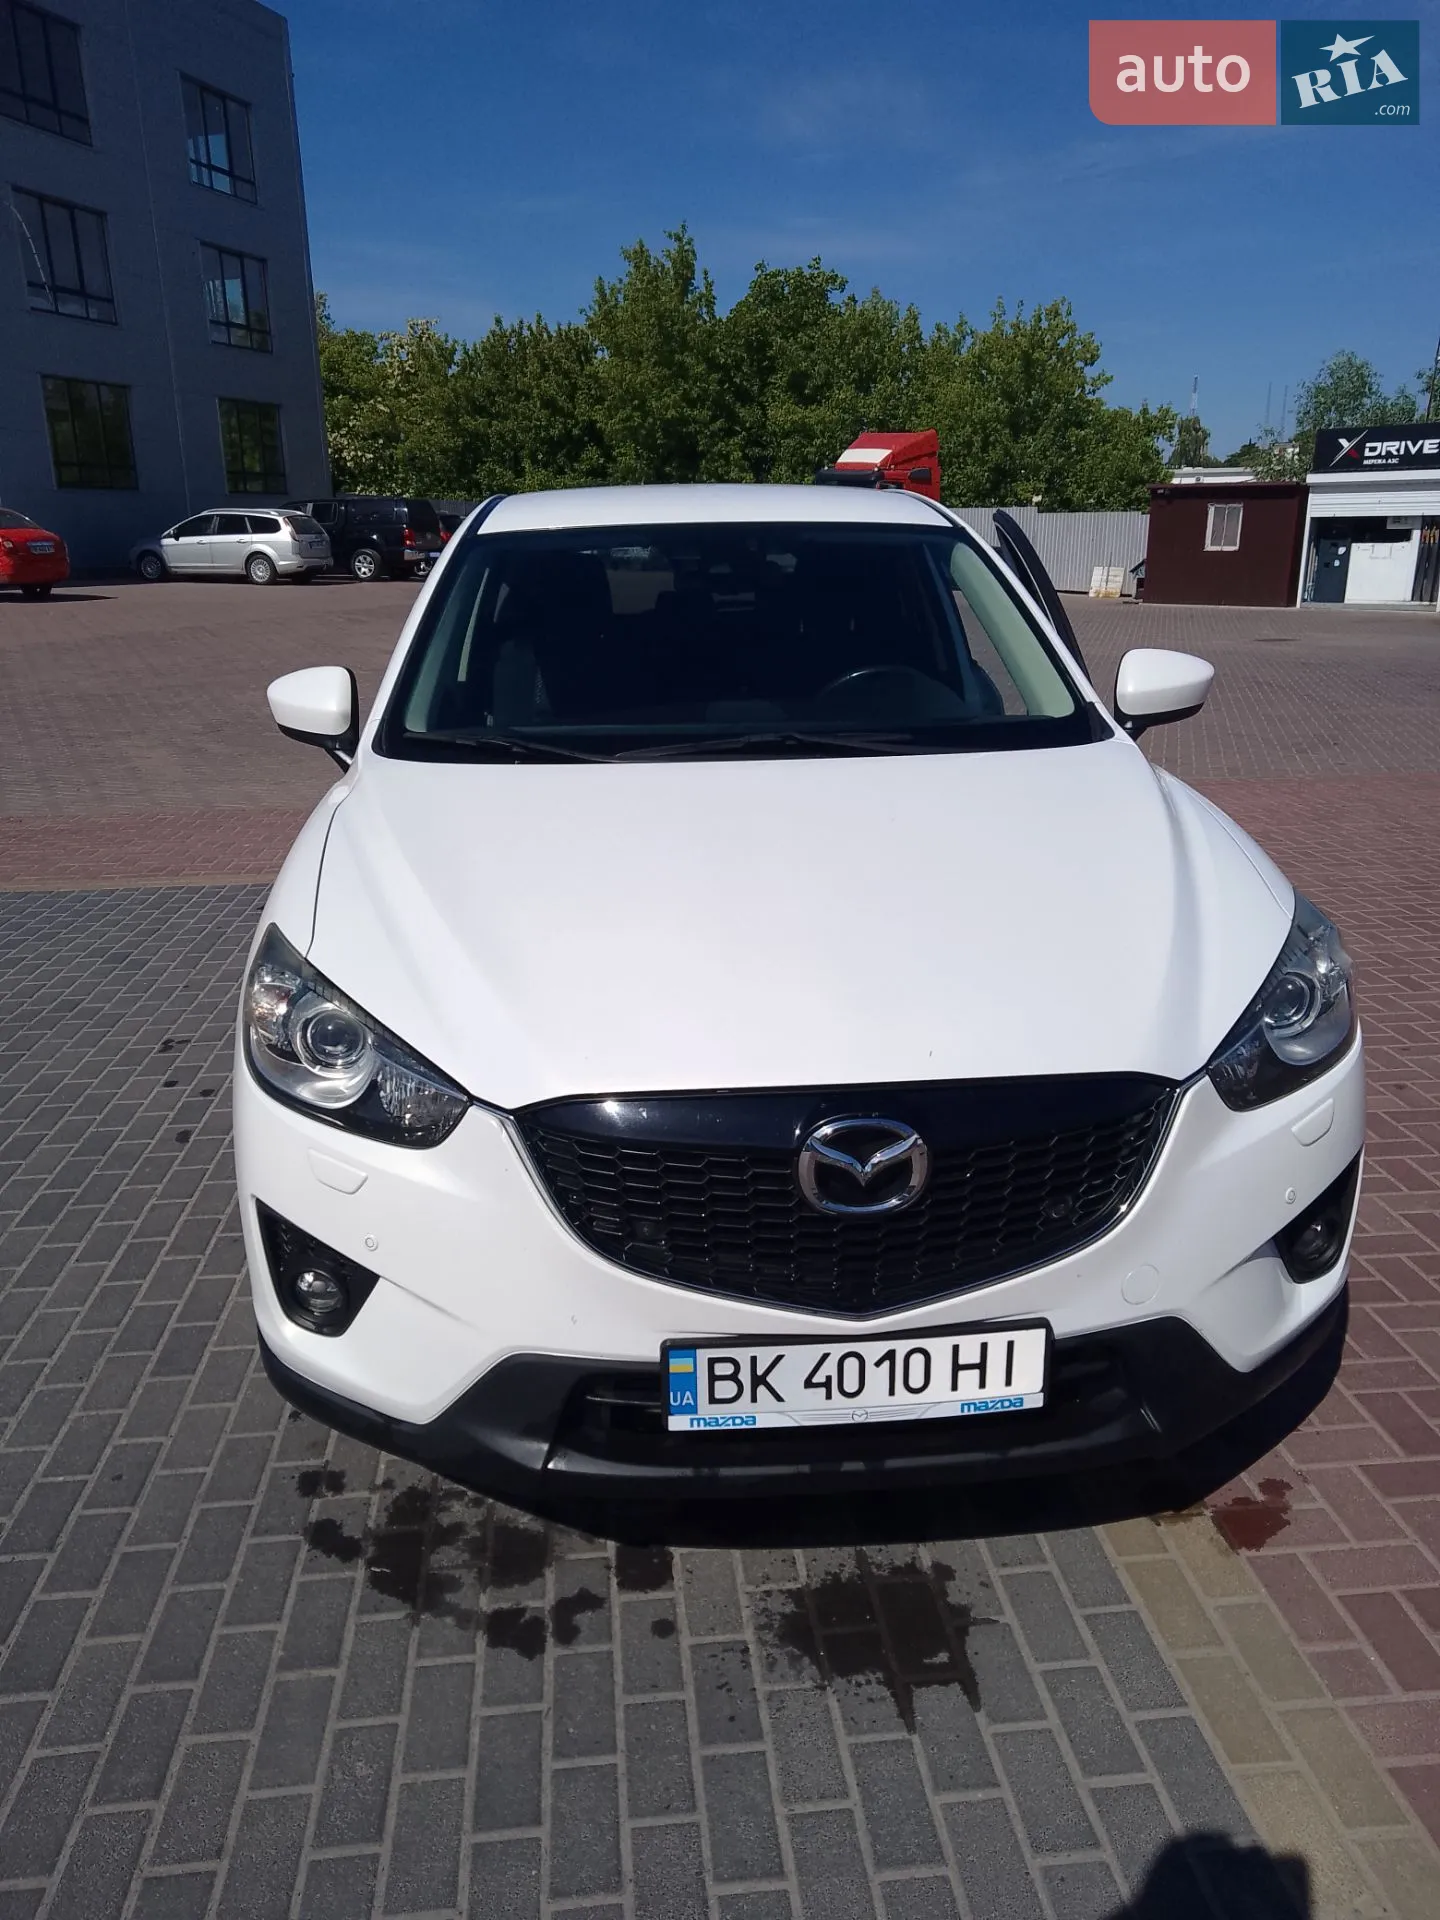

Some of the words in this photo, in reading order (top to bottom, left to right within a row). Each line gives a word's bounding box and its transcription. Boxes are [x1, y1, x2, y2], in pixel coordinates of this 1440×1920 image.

[1364, 438, 1440, 457] DRIVE
[707, 1354, 786, 1405] BK
[803, 1346, 931, 1401] 4010
[950, 1340, 1015, 1392] HI
[669, 1391, 695, 1406] UA
[960, 1397, 1024, 1414] mazda
[689, 1415, 757, 1429] mazda
